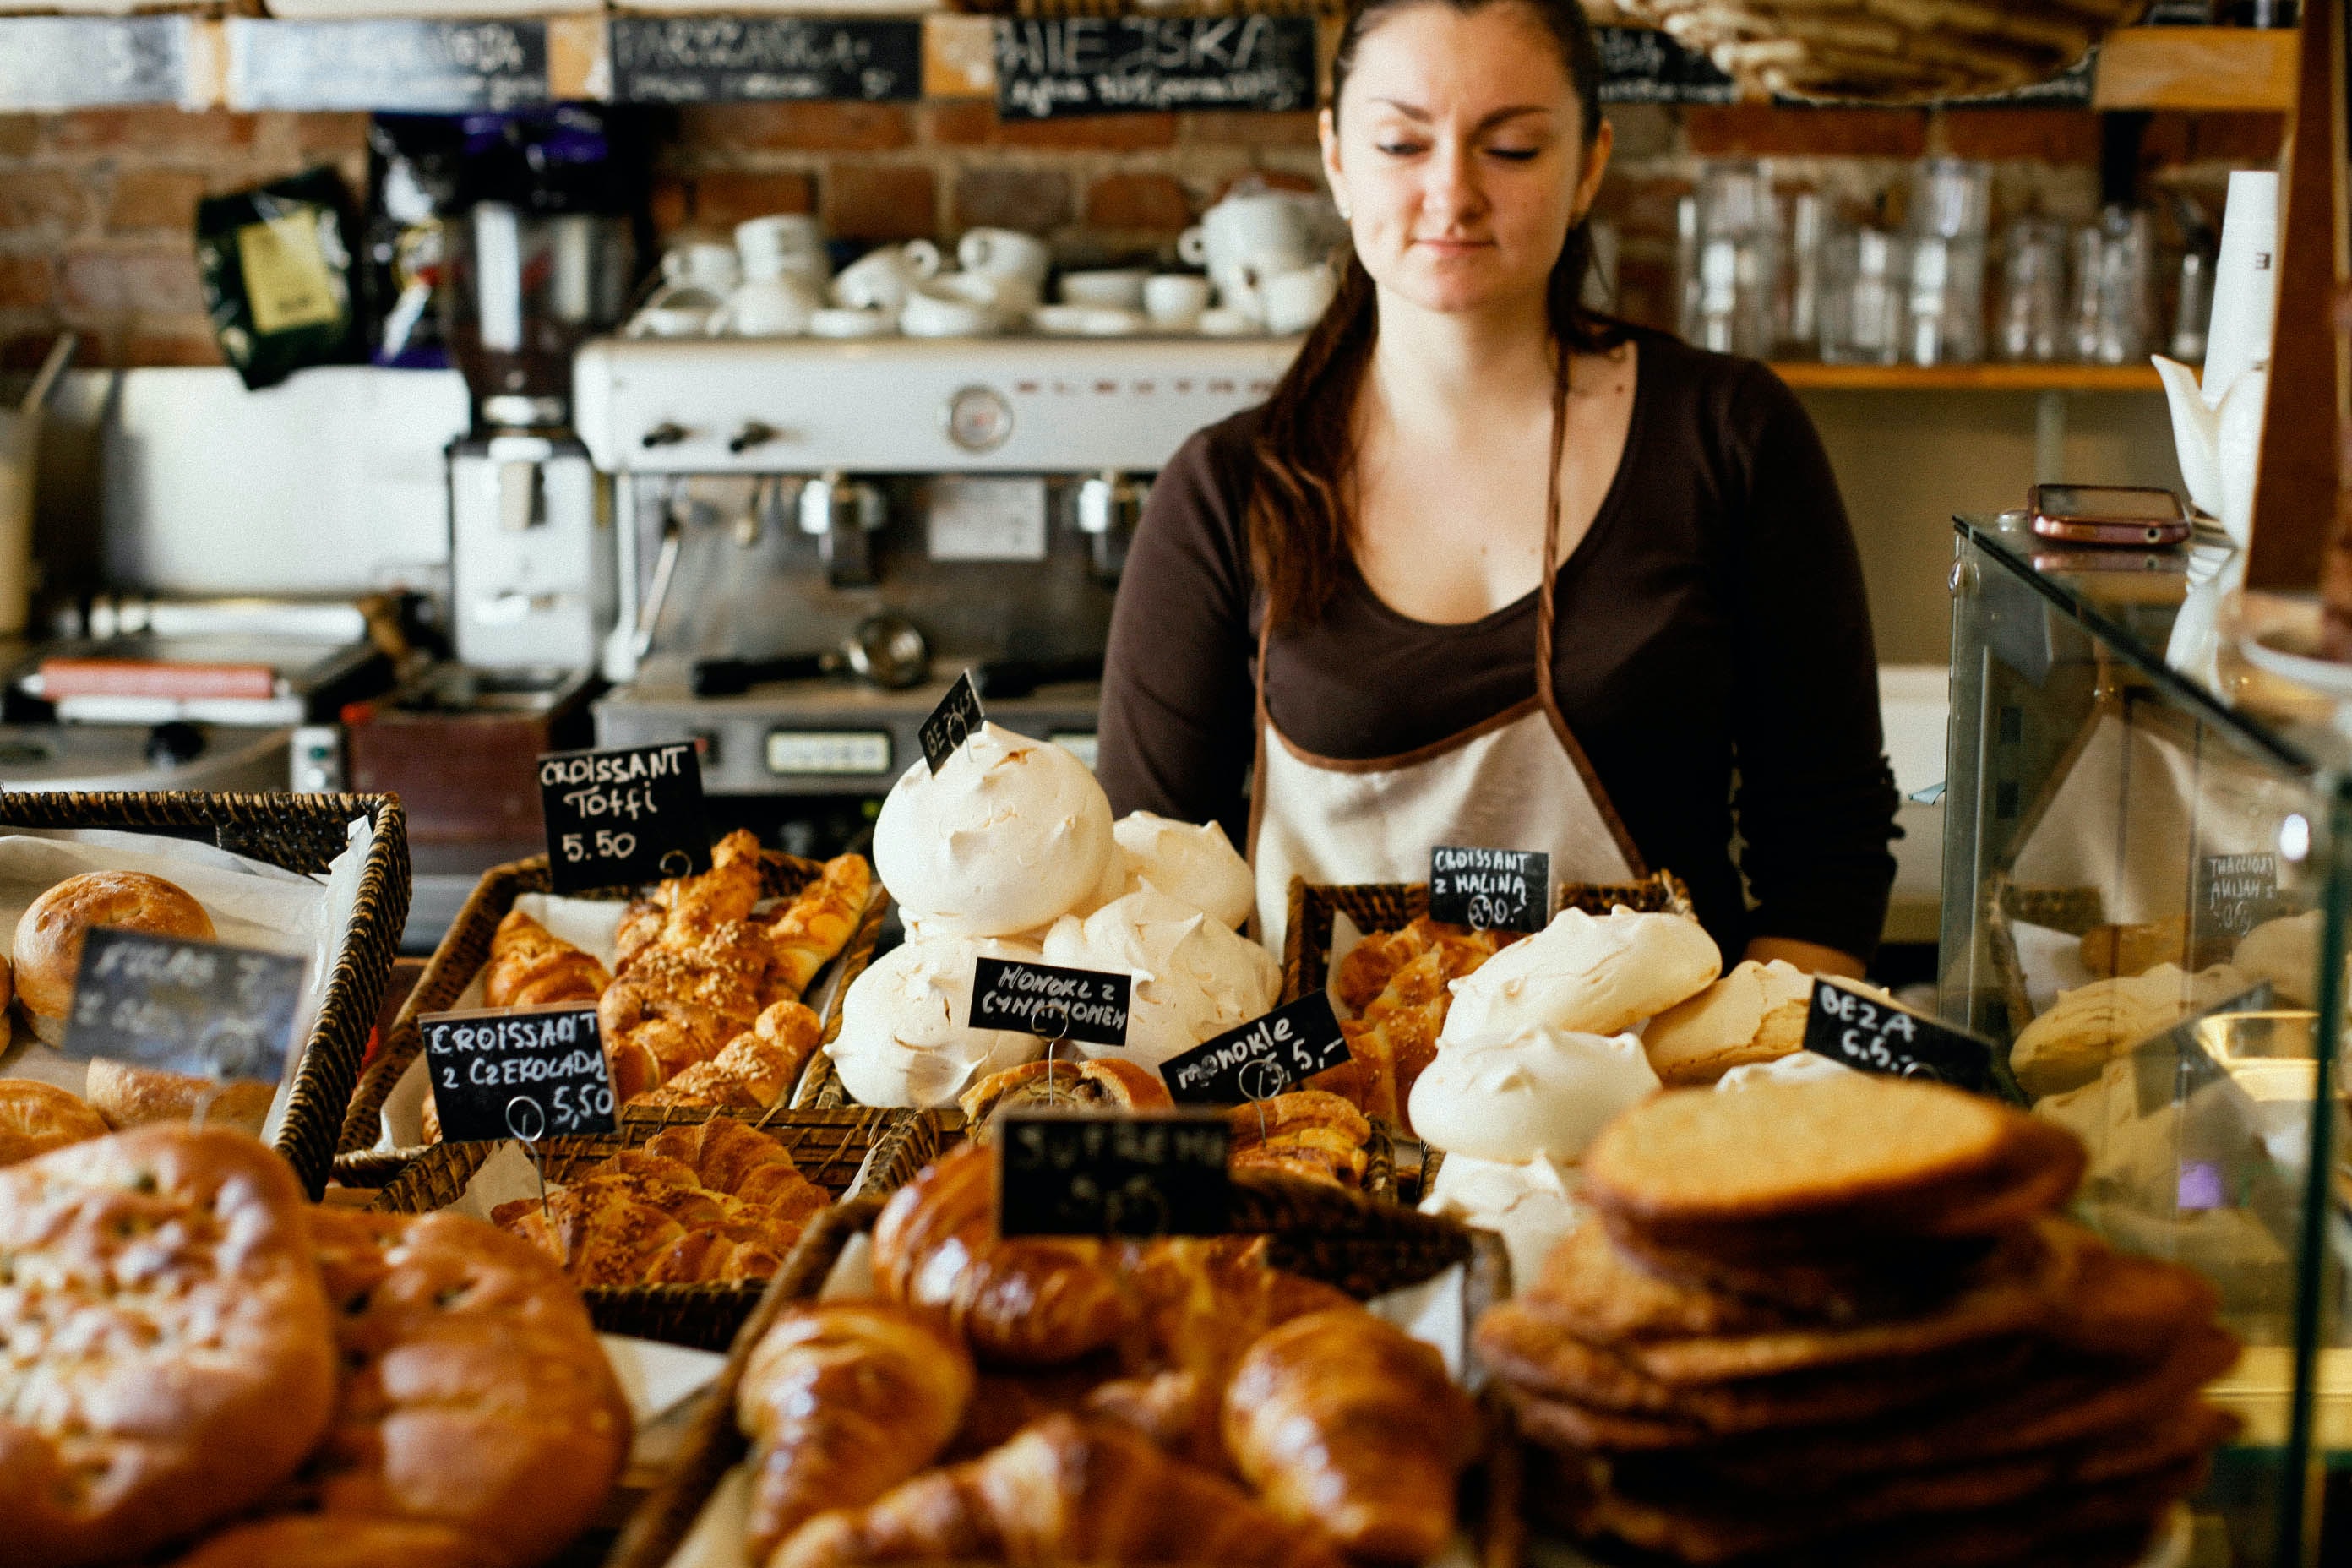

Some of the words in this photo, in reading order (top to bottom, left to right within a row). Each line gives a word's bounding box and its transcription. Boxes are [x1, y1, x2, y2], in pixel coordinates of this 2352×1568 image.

[541, 746, 688, 786] CROISSANT
[562, 830, 636, 862] 5.50
[1435, 849, 1529, 873] CROISSANT
[431, 1013, 597, 1054] CROISSANT
[553, 1084, 614, 1130] 5,50
